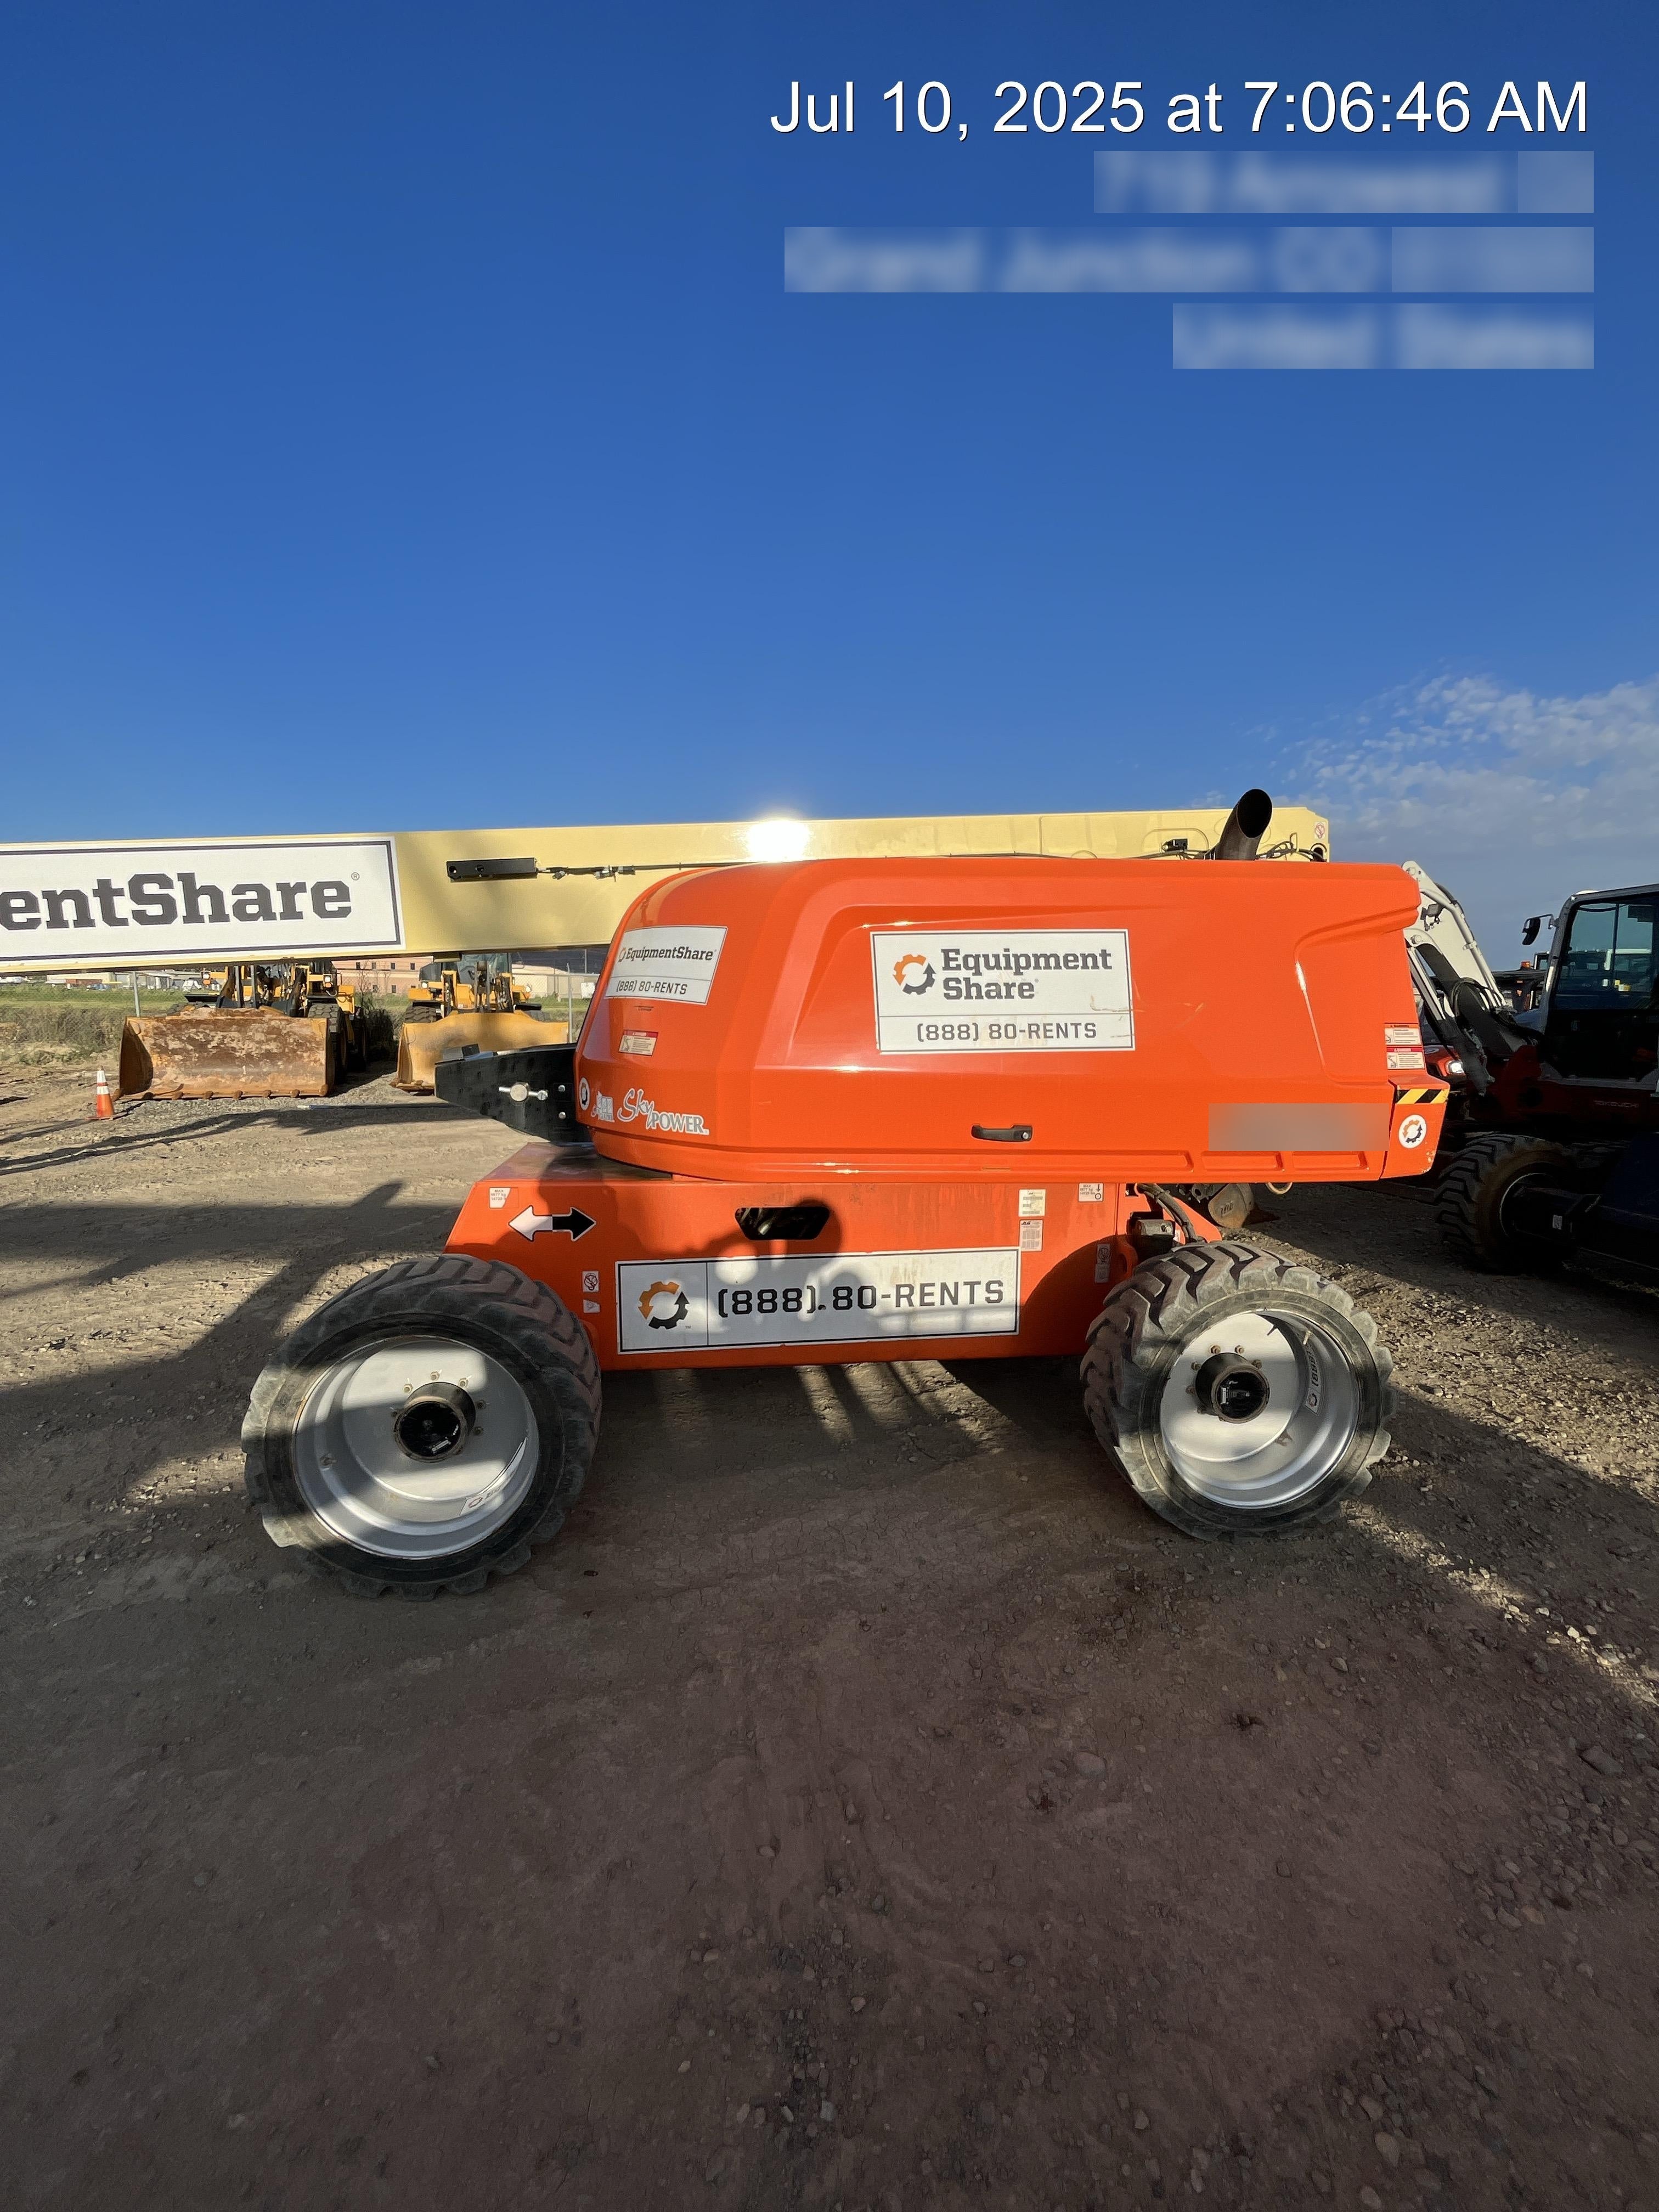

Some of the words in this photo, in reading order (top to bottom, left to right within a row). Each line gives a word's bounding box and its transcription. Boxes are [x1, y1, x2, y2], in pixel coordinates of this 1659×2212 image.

[625, 946, 714, 962] EquipmentShare
[941, 948, 1113, 976] Equipment
[616, 980, 637, 992] (888)
[639, 981, 687, 995] 80-RENTS
[943, 977, 1035, 1000] Share
[917, 1023, 979, 1042] (888)
[989, 1022, 1097, 1040] 80-RENTS
[832, 1279, 1004, 1311] 80-RENTS
